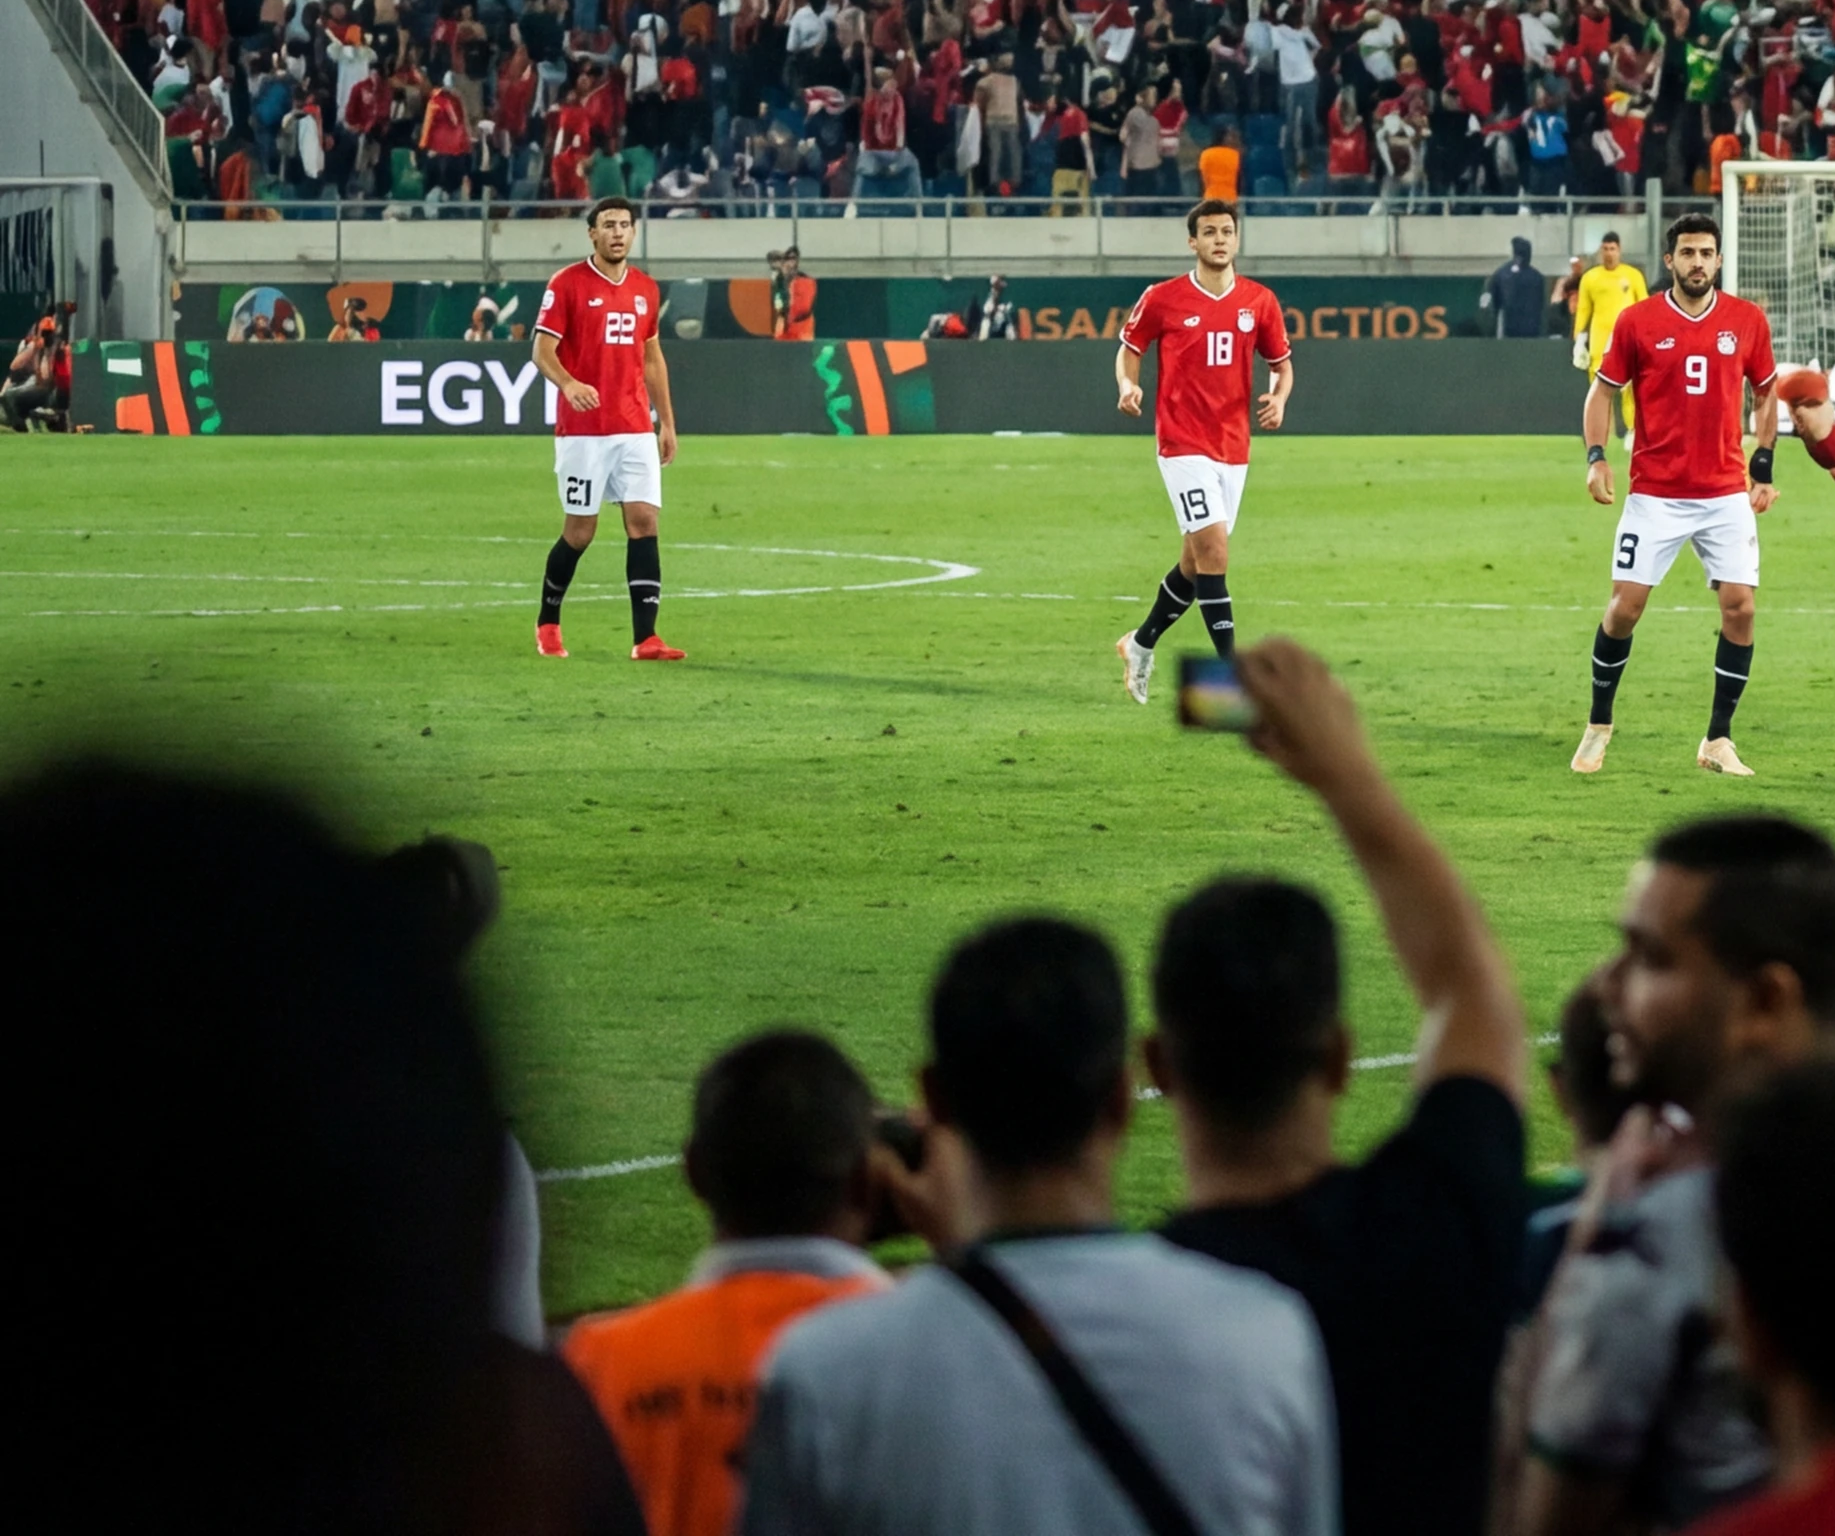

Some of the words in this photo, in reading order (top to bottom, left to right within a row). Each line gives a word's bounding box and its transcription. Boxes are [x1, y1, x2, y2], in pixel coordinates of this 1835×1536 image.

[606, 313, 636, 345] 22
[1207, 331, 1234, 366] 18
[381, 361, 558, 425] EGY
[1685, 355, 1708, 395] 9
